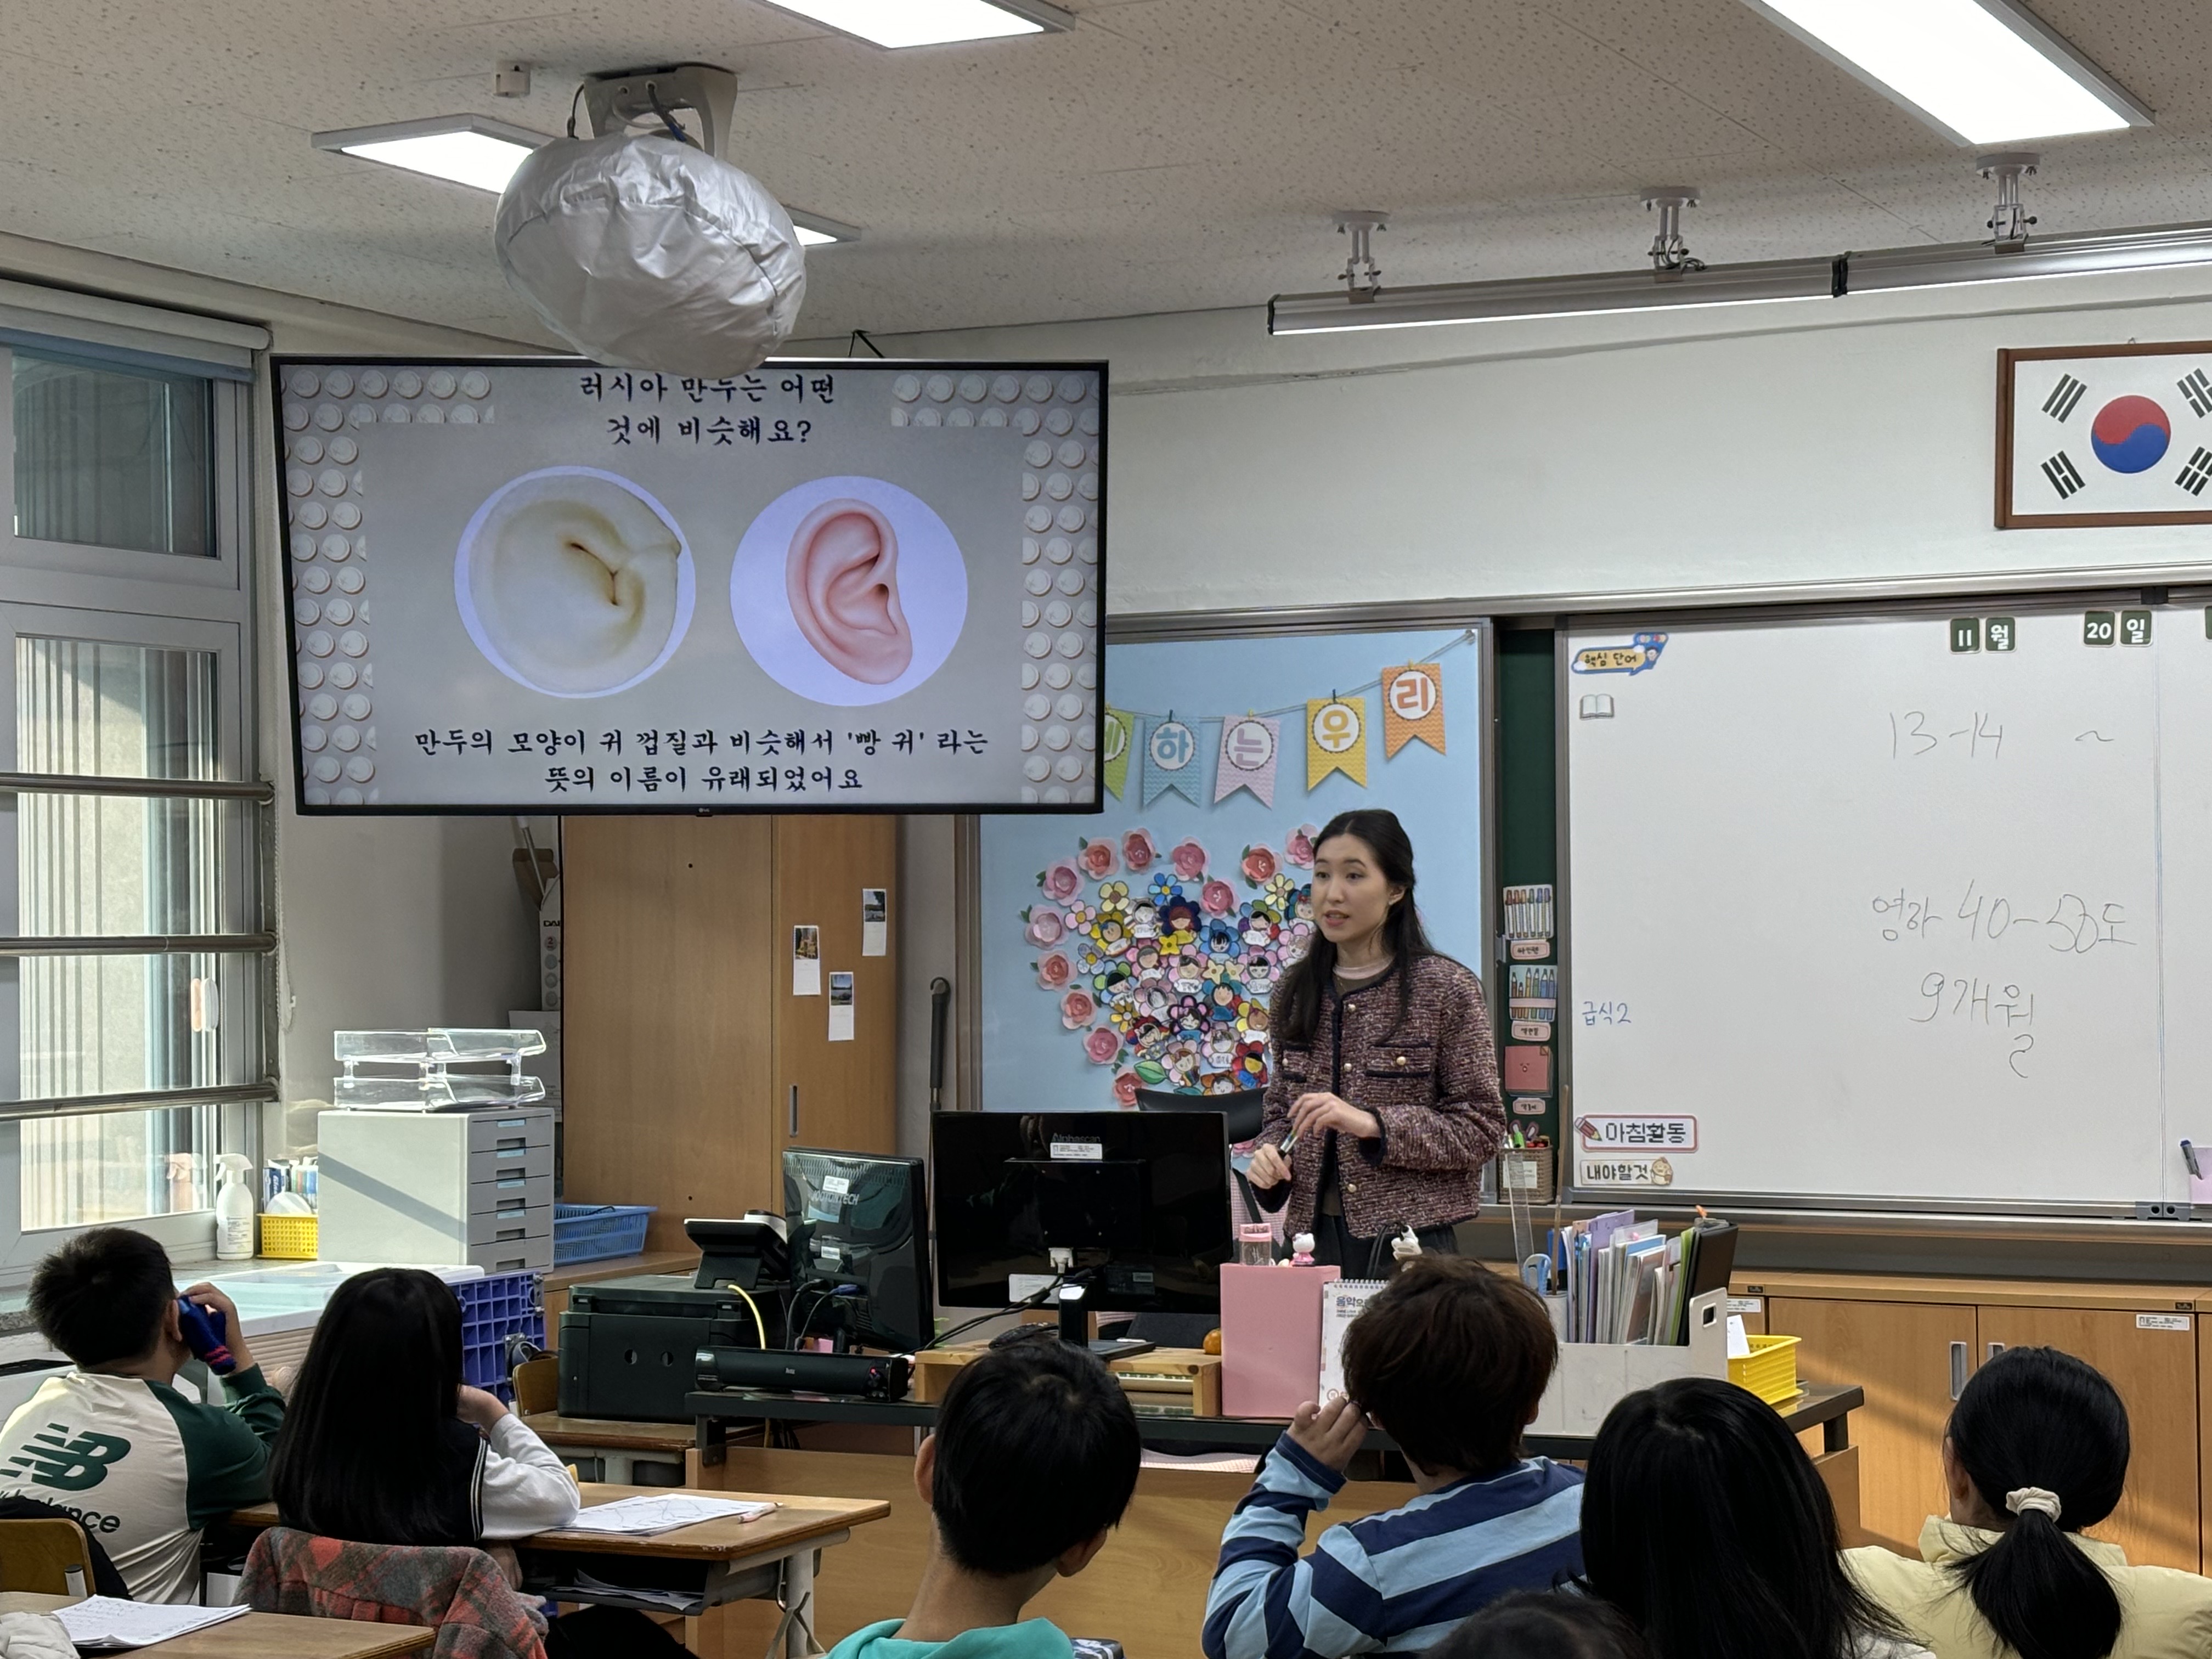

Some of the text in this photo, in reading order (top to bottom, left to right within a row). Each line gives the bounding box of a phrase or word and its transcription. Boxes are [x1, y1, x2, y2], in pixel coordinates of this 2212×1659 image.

[580, 372, 834, 404] 러시아 만두는 어떤
[607, 415, 811, 445] 것에 비슷해요?
[1613, 653, 1637, 666] 단어
[414, 729, 988, 756] 만두의 모양이 귀 껍질과 비슷해서 '빵 귀' 라는
[1889, 711, 2003, 760] 13-14
[544, 765, 863, 793] 뜻의 이름이 유래되었어요
[1606, 1122, 1686, 1143] 아침활동
[1587, 1164, 1649, 1181] 내야할것
